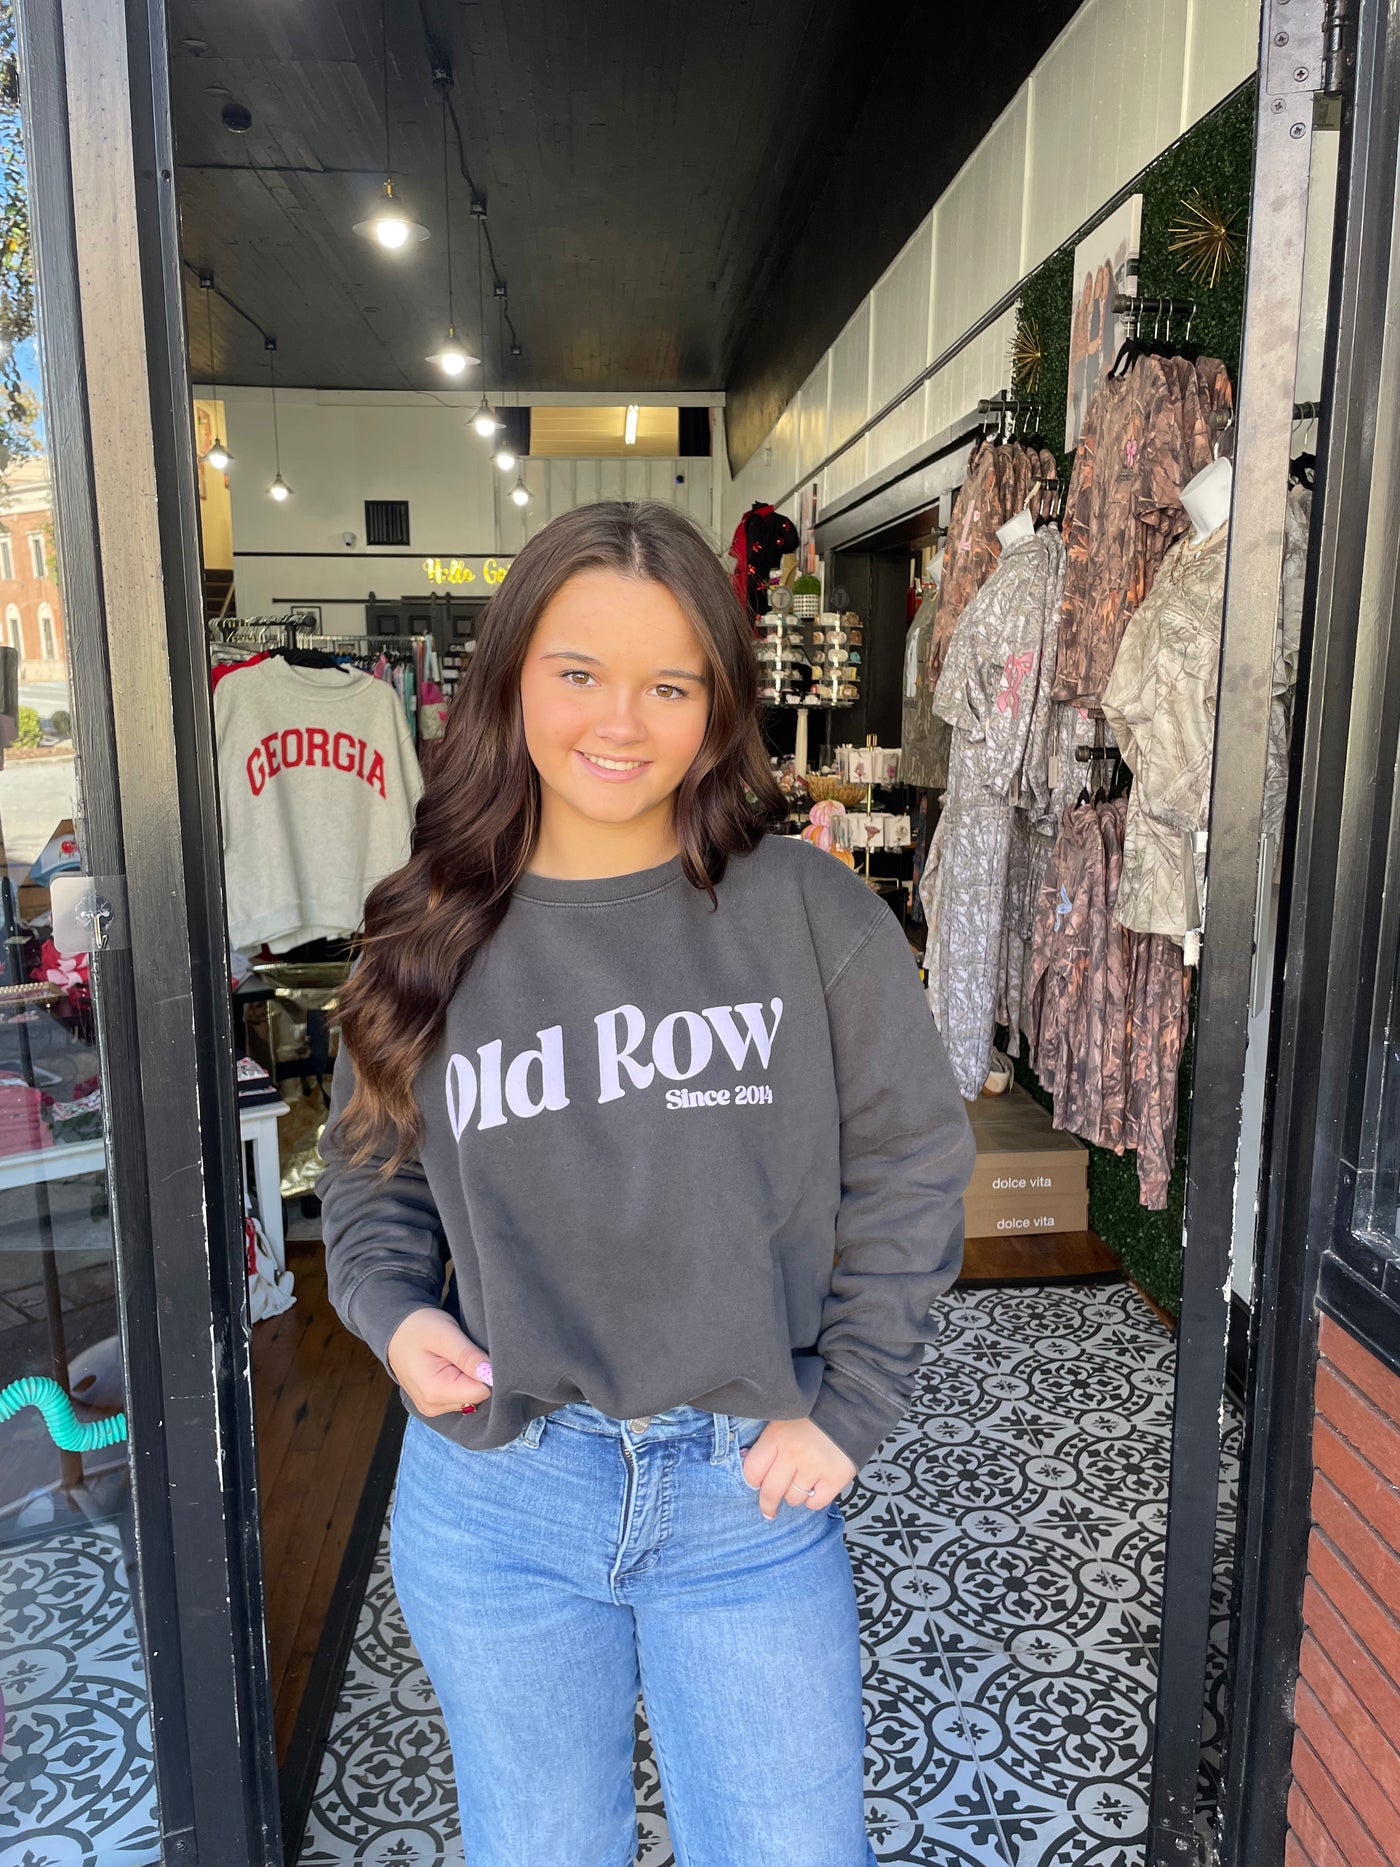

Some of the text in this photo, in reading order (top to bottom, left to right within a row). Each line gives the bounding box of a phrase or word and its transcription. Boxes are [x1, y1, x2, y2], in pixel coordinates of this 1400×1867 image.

[422, 558, 511, 584] Hello Go
[246, 727, 386, 800] GEORGIA
[445, 997, 783, 1144] Old Row
[665, 1084, 773, 1109] Since 2014
[992, 1176, 1052, 1189] dolce vita
[996, 1216, 1055, 1230] dolce vita
